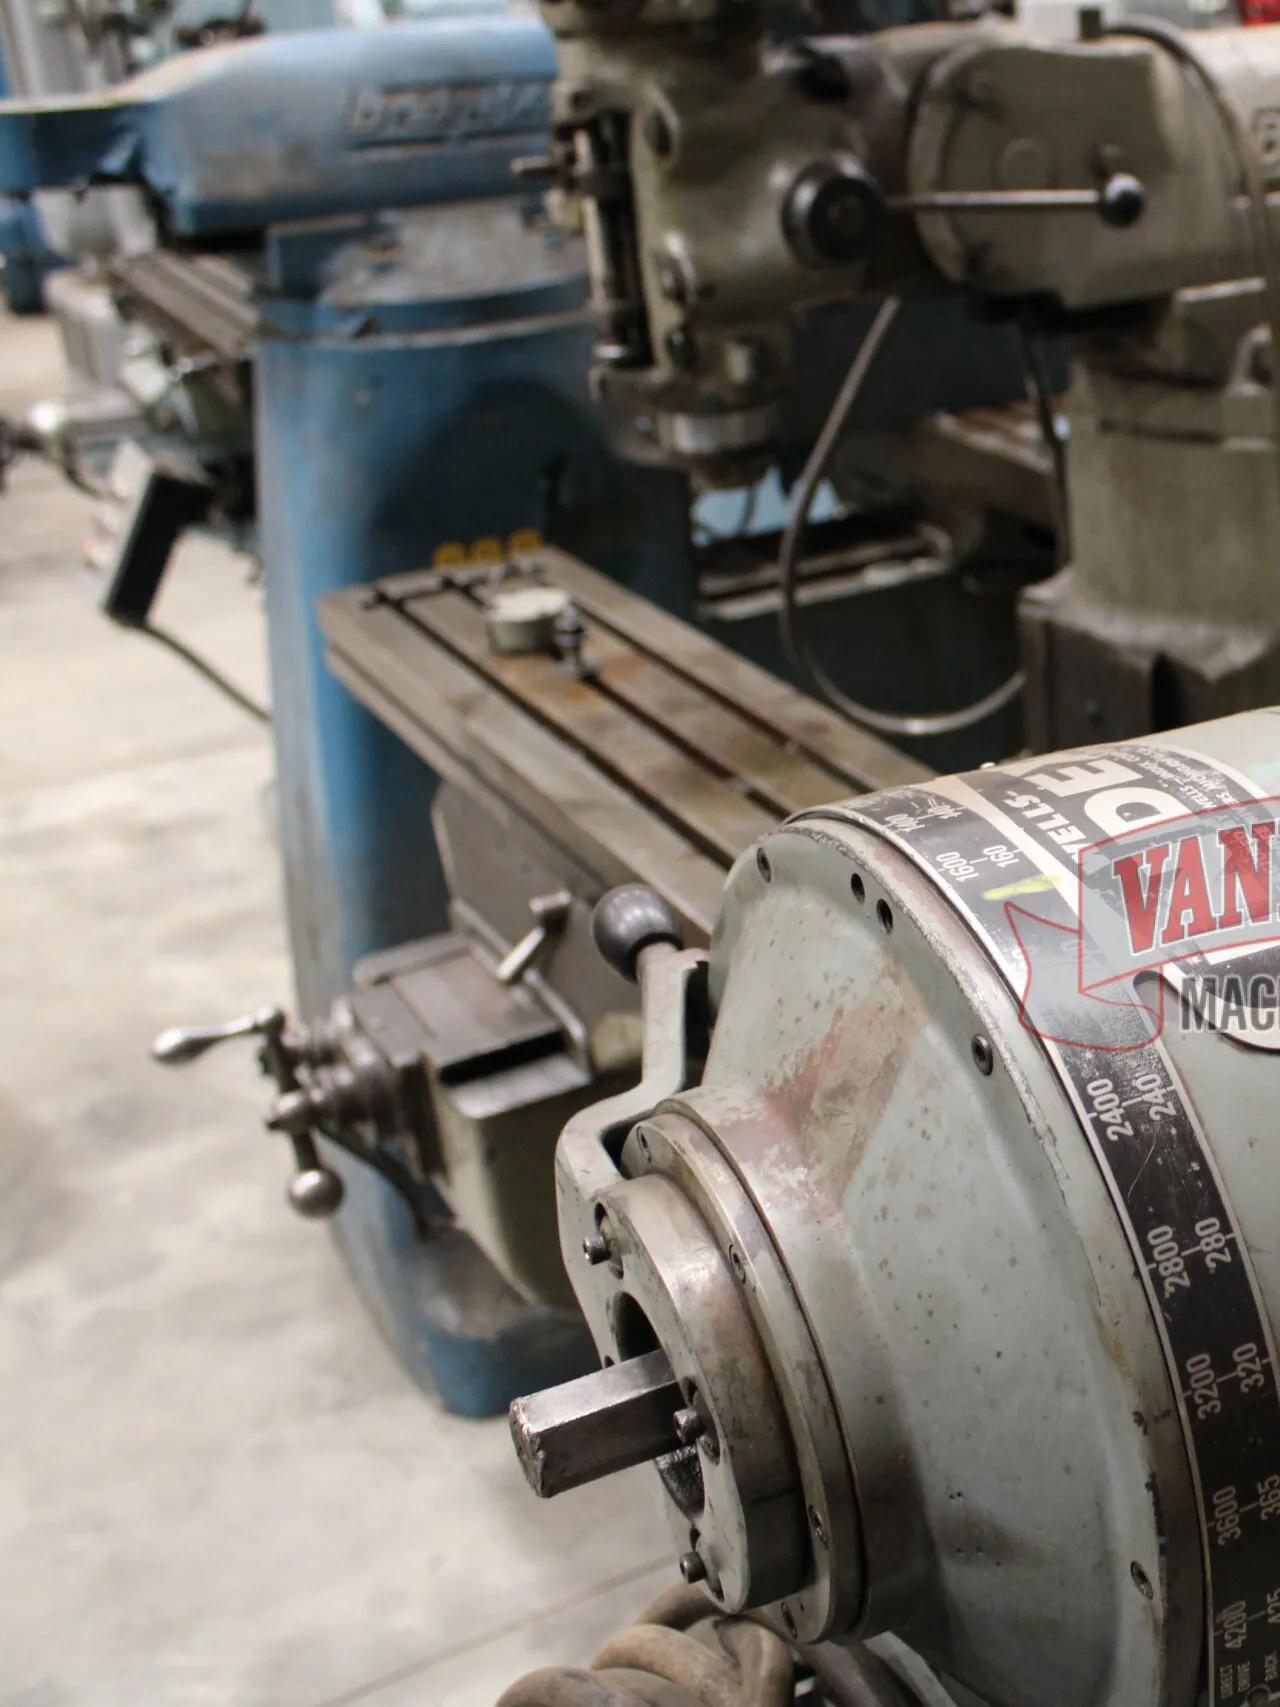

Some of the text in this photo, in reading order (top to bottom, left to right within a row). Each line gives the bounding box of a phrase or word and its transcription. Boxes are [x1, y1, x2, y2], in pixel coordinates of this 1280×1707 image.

[935, 851, 980, 882] 1600
[982, 844, 1020, 868] 160
[1086, 1077, 1134, 1142] 2400
[1135, 1072, 1177, 1121] 240
[1146, 1225, 1191, 1296] 2800
[1194, 1217, 1233, 1270] 280
[1186, 1352, 1223, 1421] 3200
[1232, 1341, 1265, 1394] 320
[1212, 1484, 1242, 1547] 3600
[1217, 1600, 1248, 1651] 4200
